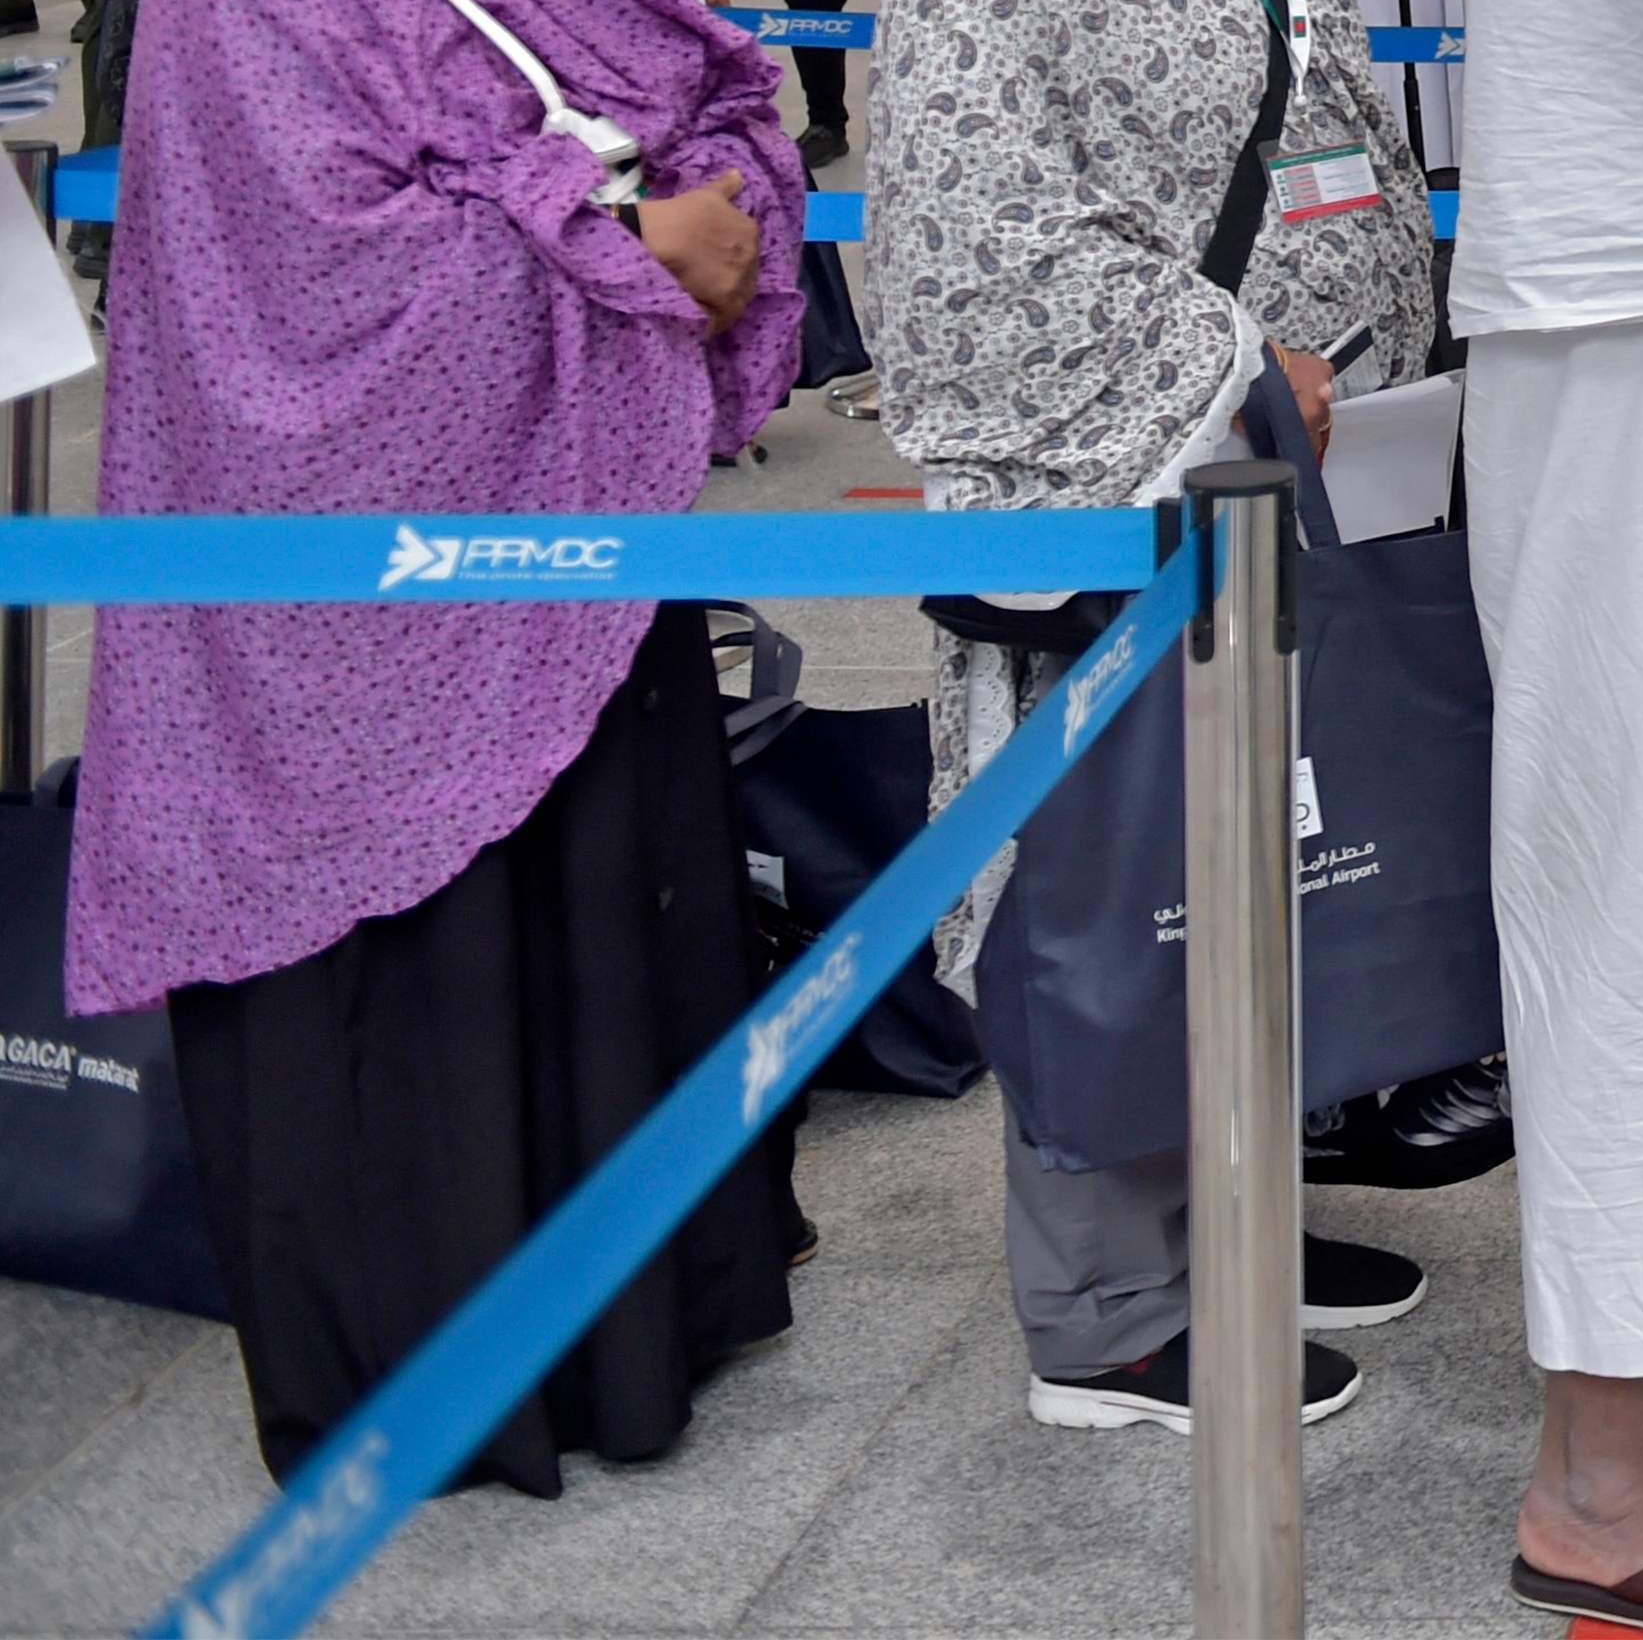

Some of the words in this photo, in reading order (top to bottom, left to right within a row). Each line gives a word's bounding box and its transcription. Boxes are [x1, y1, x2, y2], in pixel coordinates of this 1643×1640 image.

[1327, 841, 1377, 868] مطار
[1332, 860, 1382, 886] Airport
[7, 1034, 72, 1072] GACA
